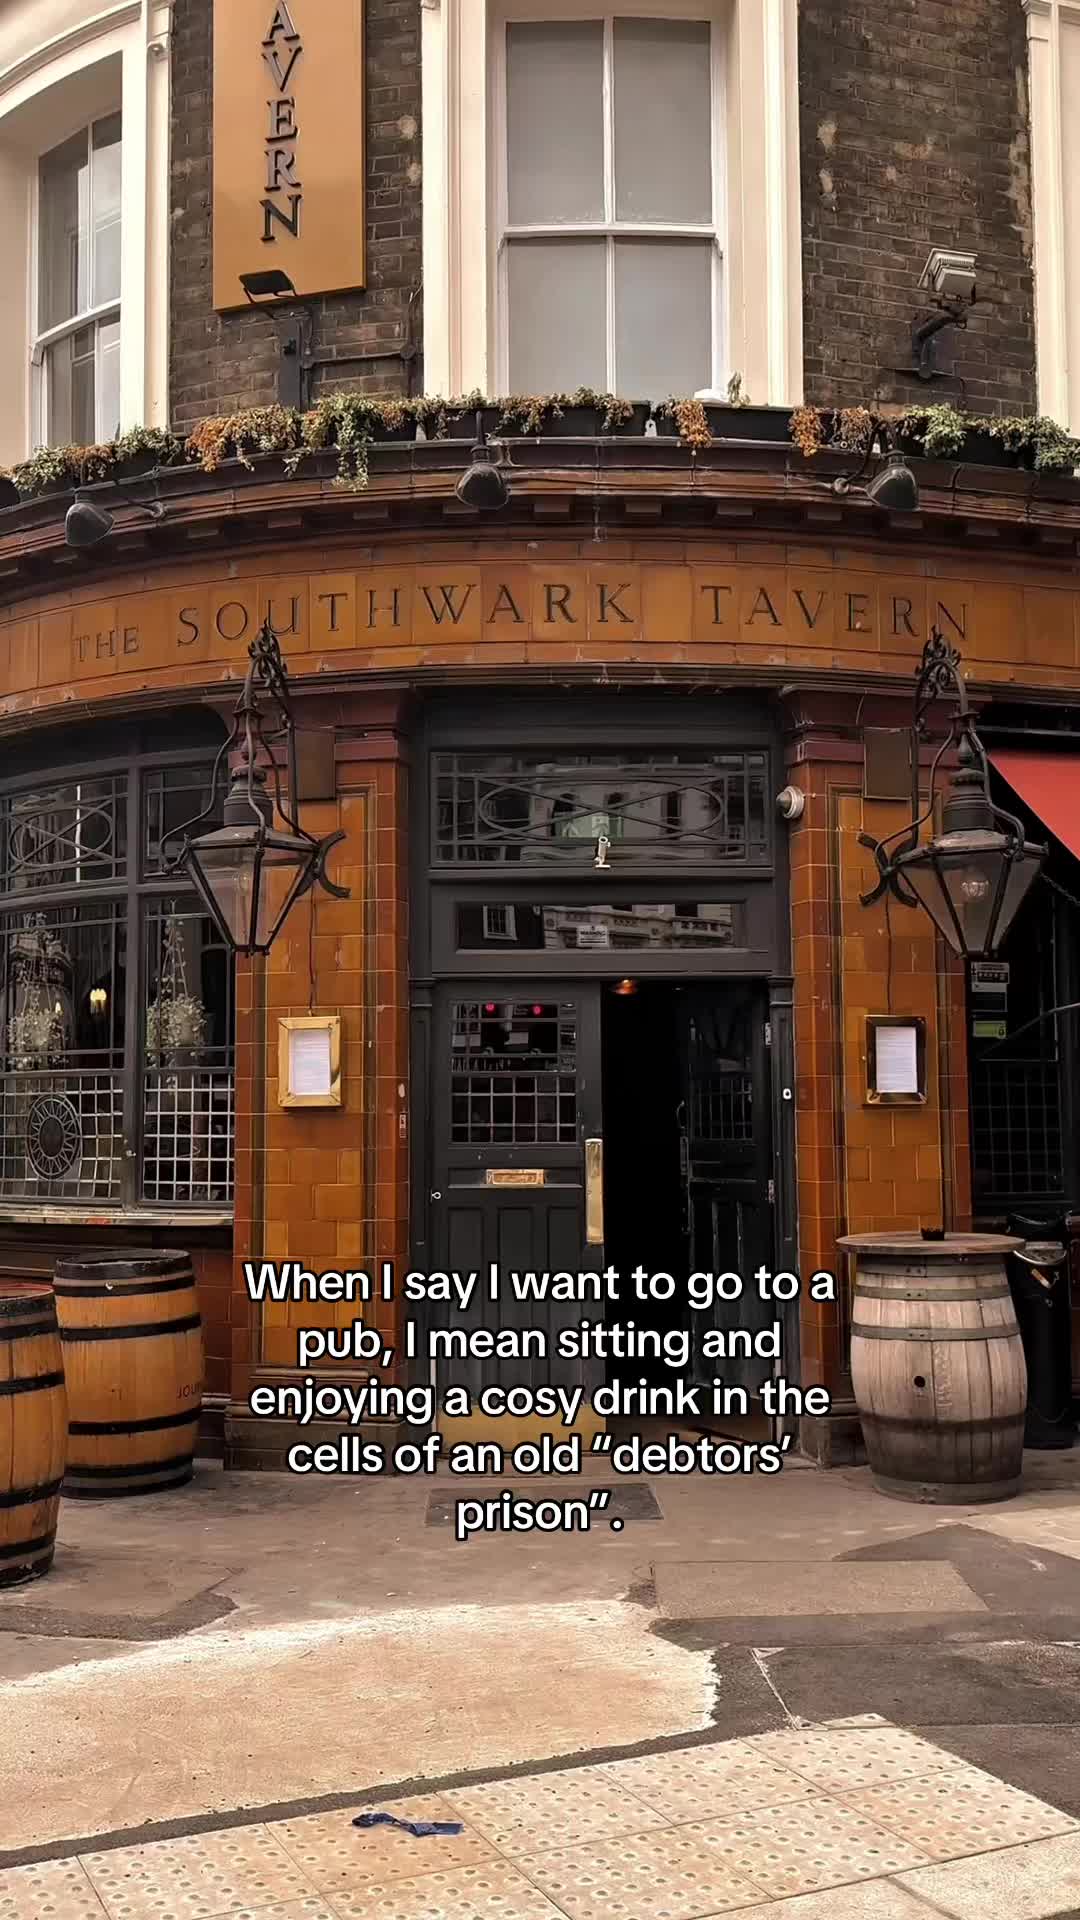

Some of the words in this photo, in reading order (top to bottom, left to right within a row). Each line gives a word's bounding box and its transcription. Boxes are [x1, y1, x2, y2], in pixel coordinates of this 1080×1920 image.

[71, 626, 140, 662] THE
[176, 583, 635, 647] SOUTHWARK
[701, 585, 968, 640] TAVERN
